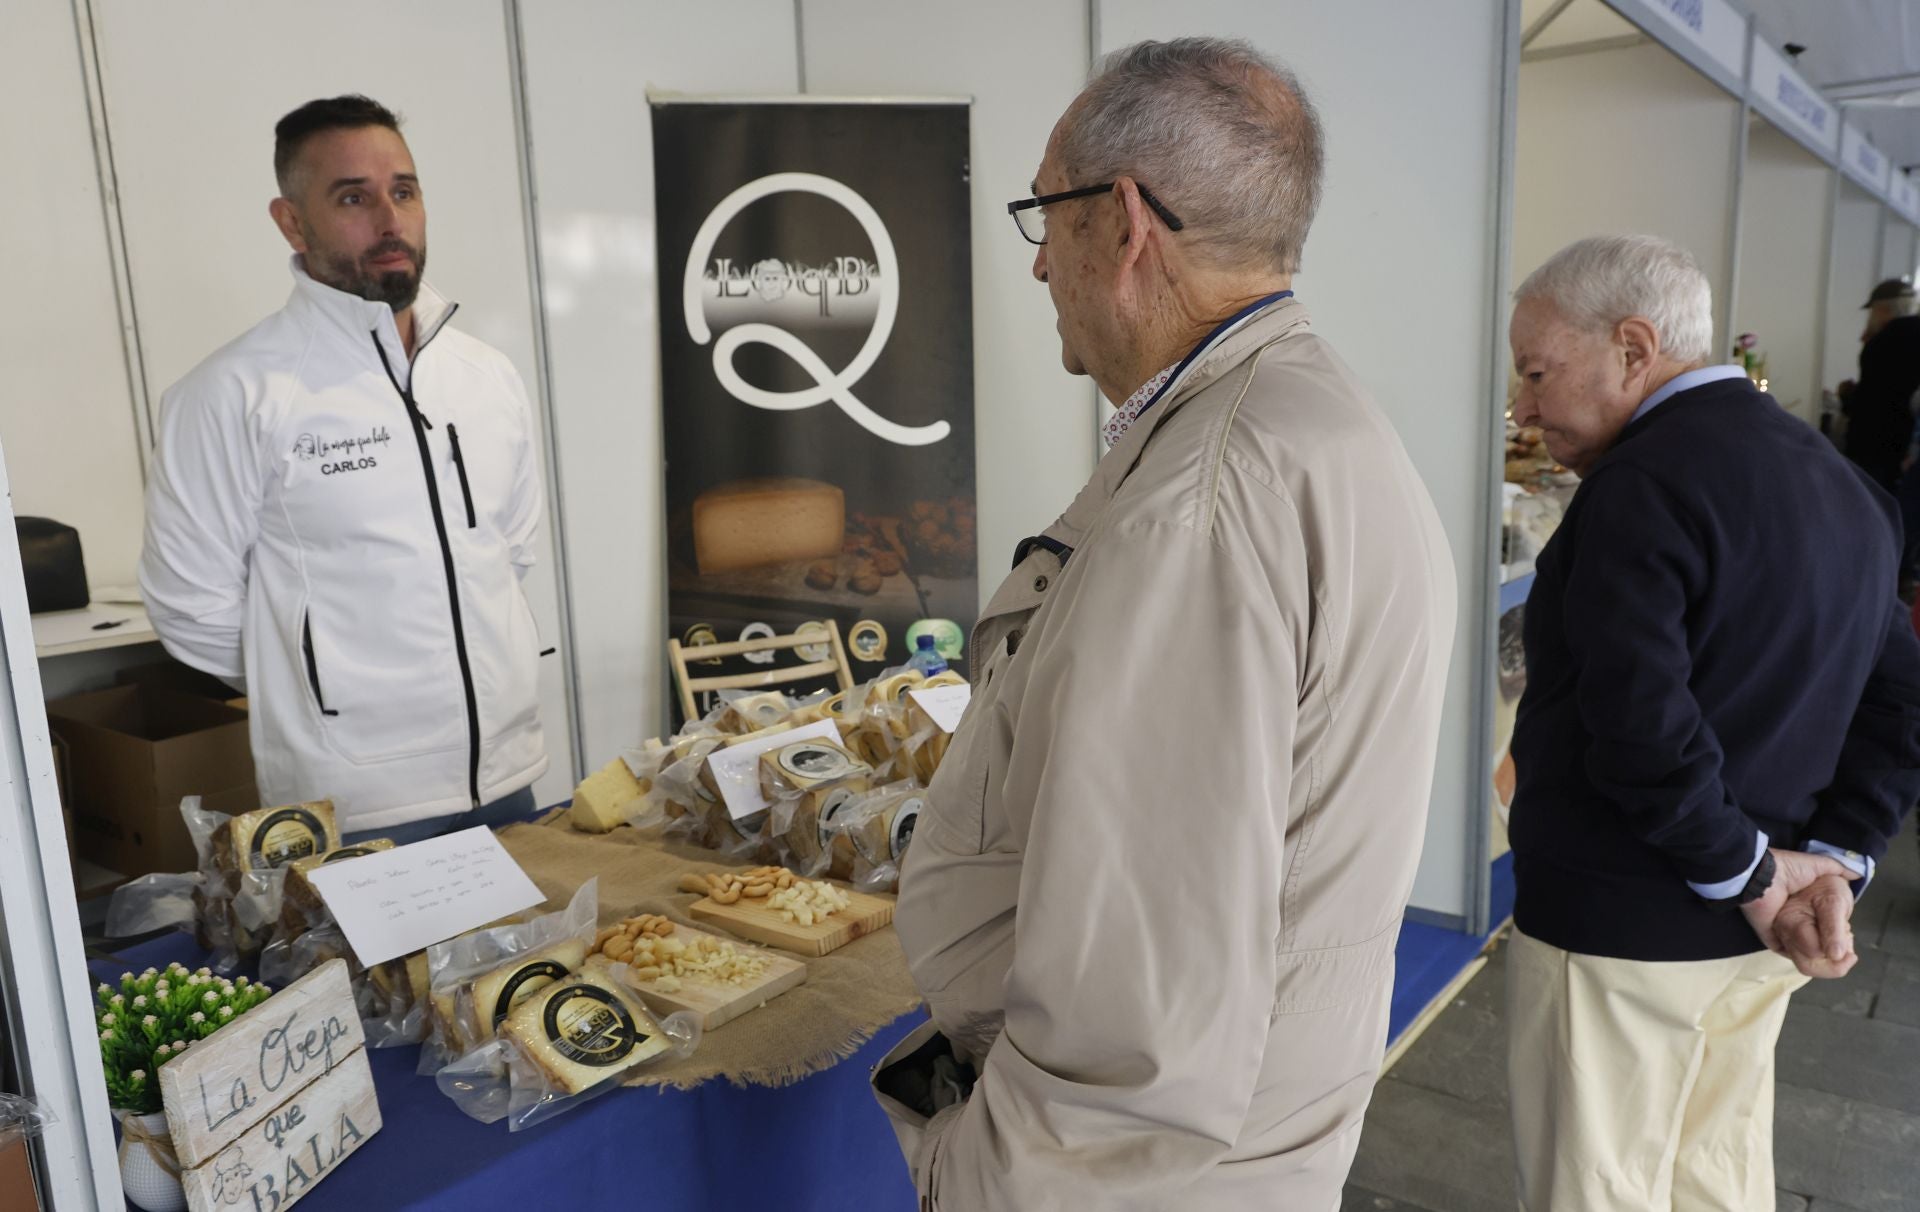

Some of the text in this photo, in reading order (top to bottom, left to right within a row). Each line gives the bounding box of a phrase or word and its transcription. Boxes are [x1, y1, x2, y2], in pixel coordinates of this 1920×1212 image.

[321, 457, 377, 475] CARLOS
[199, 1012, 348, 1132] La Oveja
[246, 1112, 364, 1212] BALA
[264, 1104, 306, 1149] que
